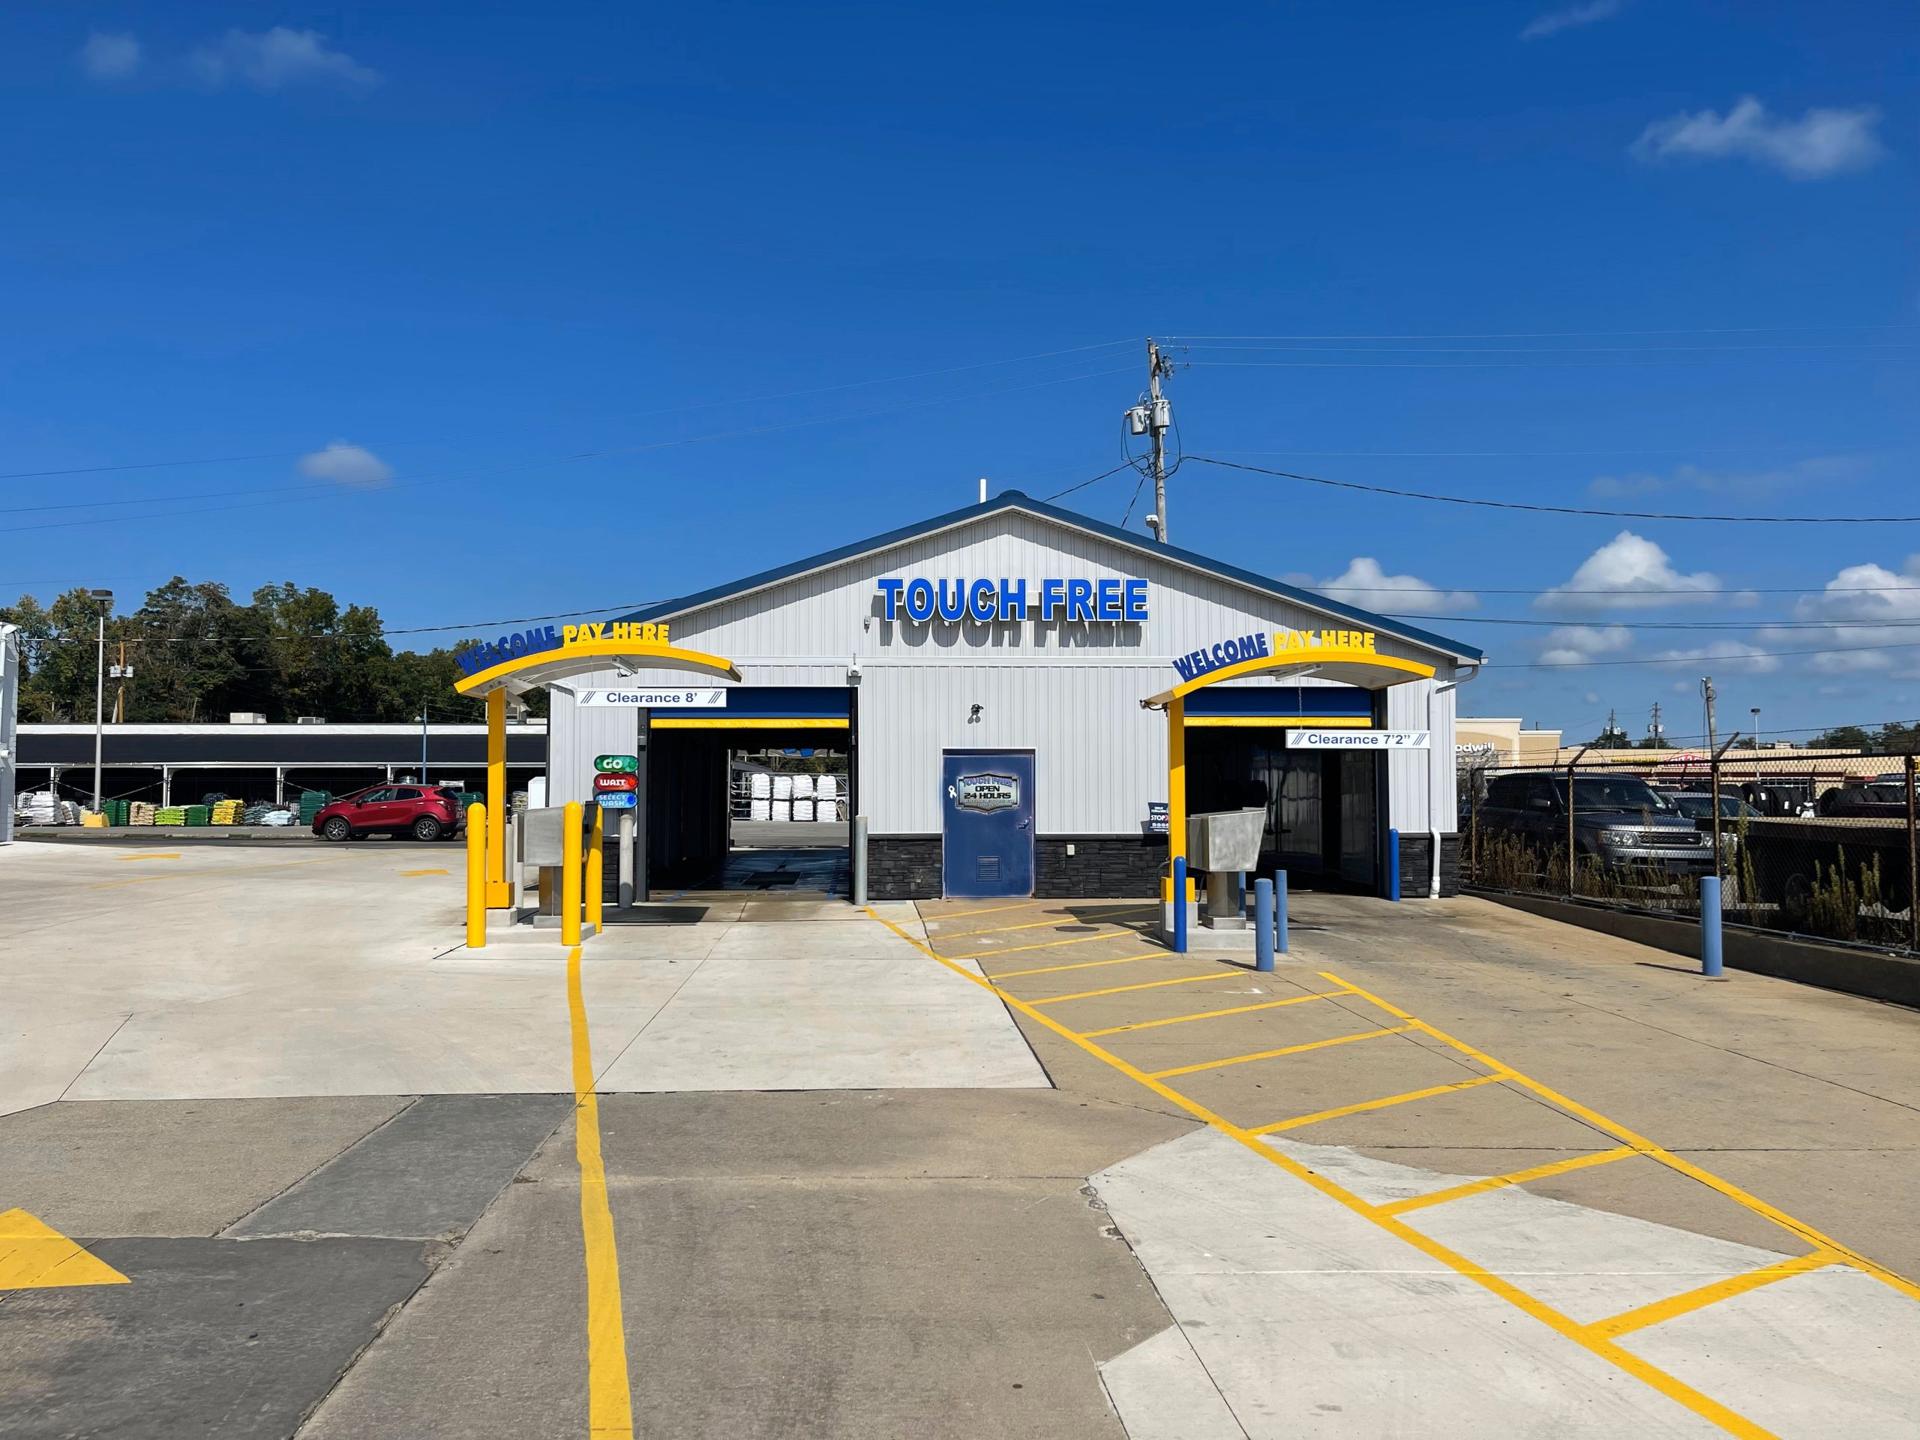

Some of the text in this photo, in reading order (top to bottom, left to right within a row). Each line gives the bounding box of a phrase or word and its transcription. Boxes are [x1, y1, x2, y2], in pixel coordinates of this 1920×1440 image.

[877, 577, 1149, 622] TOUCH FREE
[454, 622, 670, 674] WELCOME PAY HERE
[1172, 630, 1376, 681] WELCOME PAY HERE
[606, 691, 698, 704] Clearance 8'
[1307, 733, 1379, 745] Clearance
[1455, 742, 1494, 752] odwill
[603, 759, 623, 768] GO
